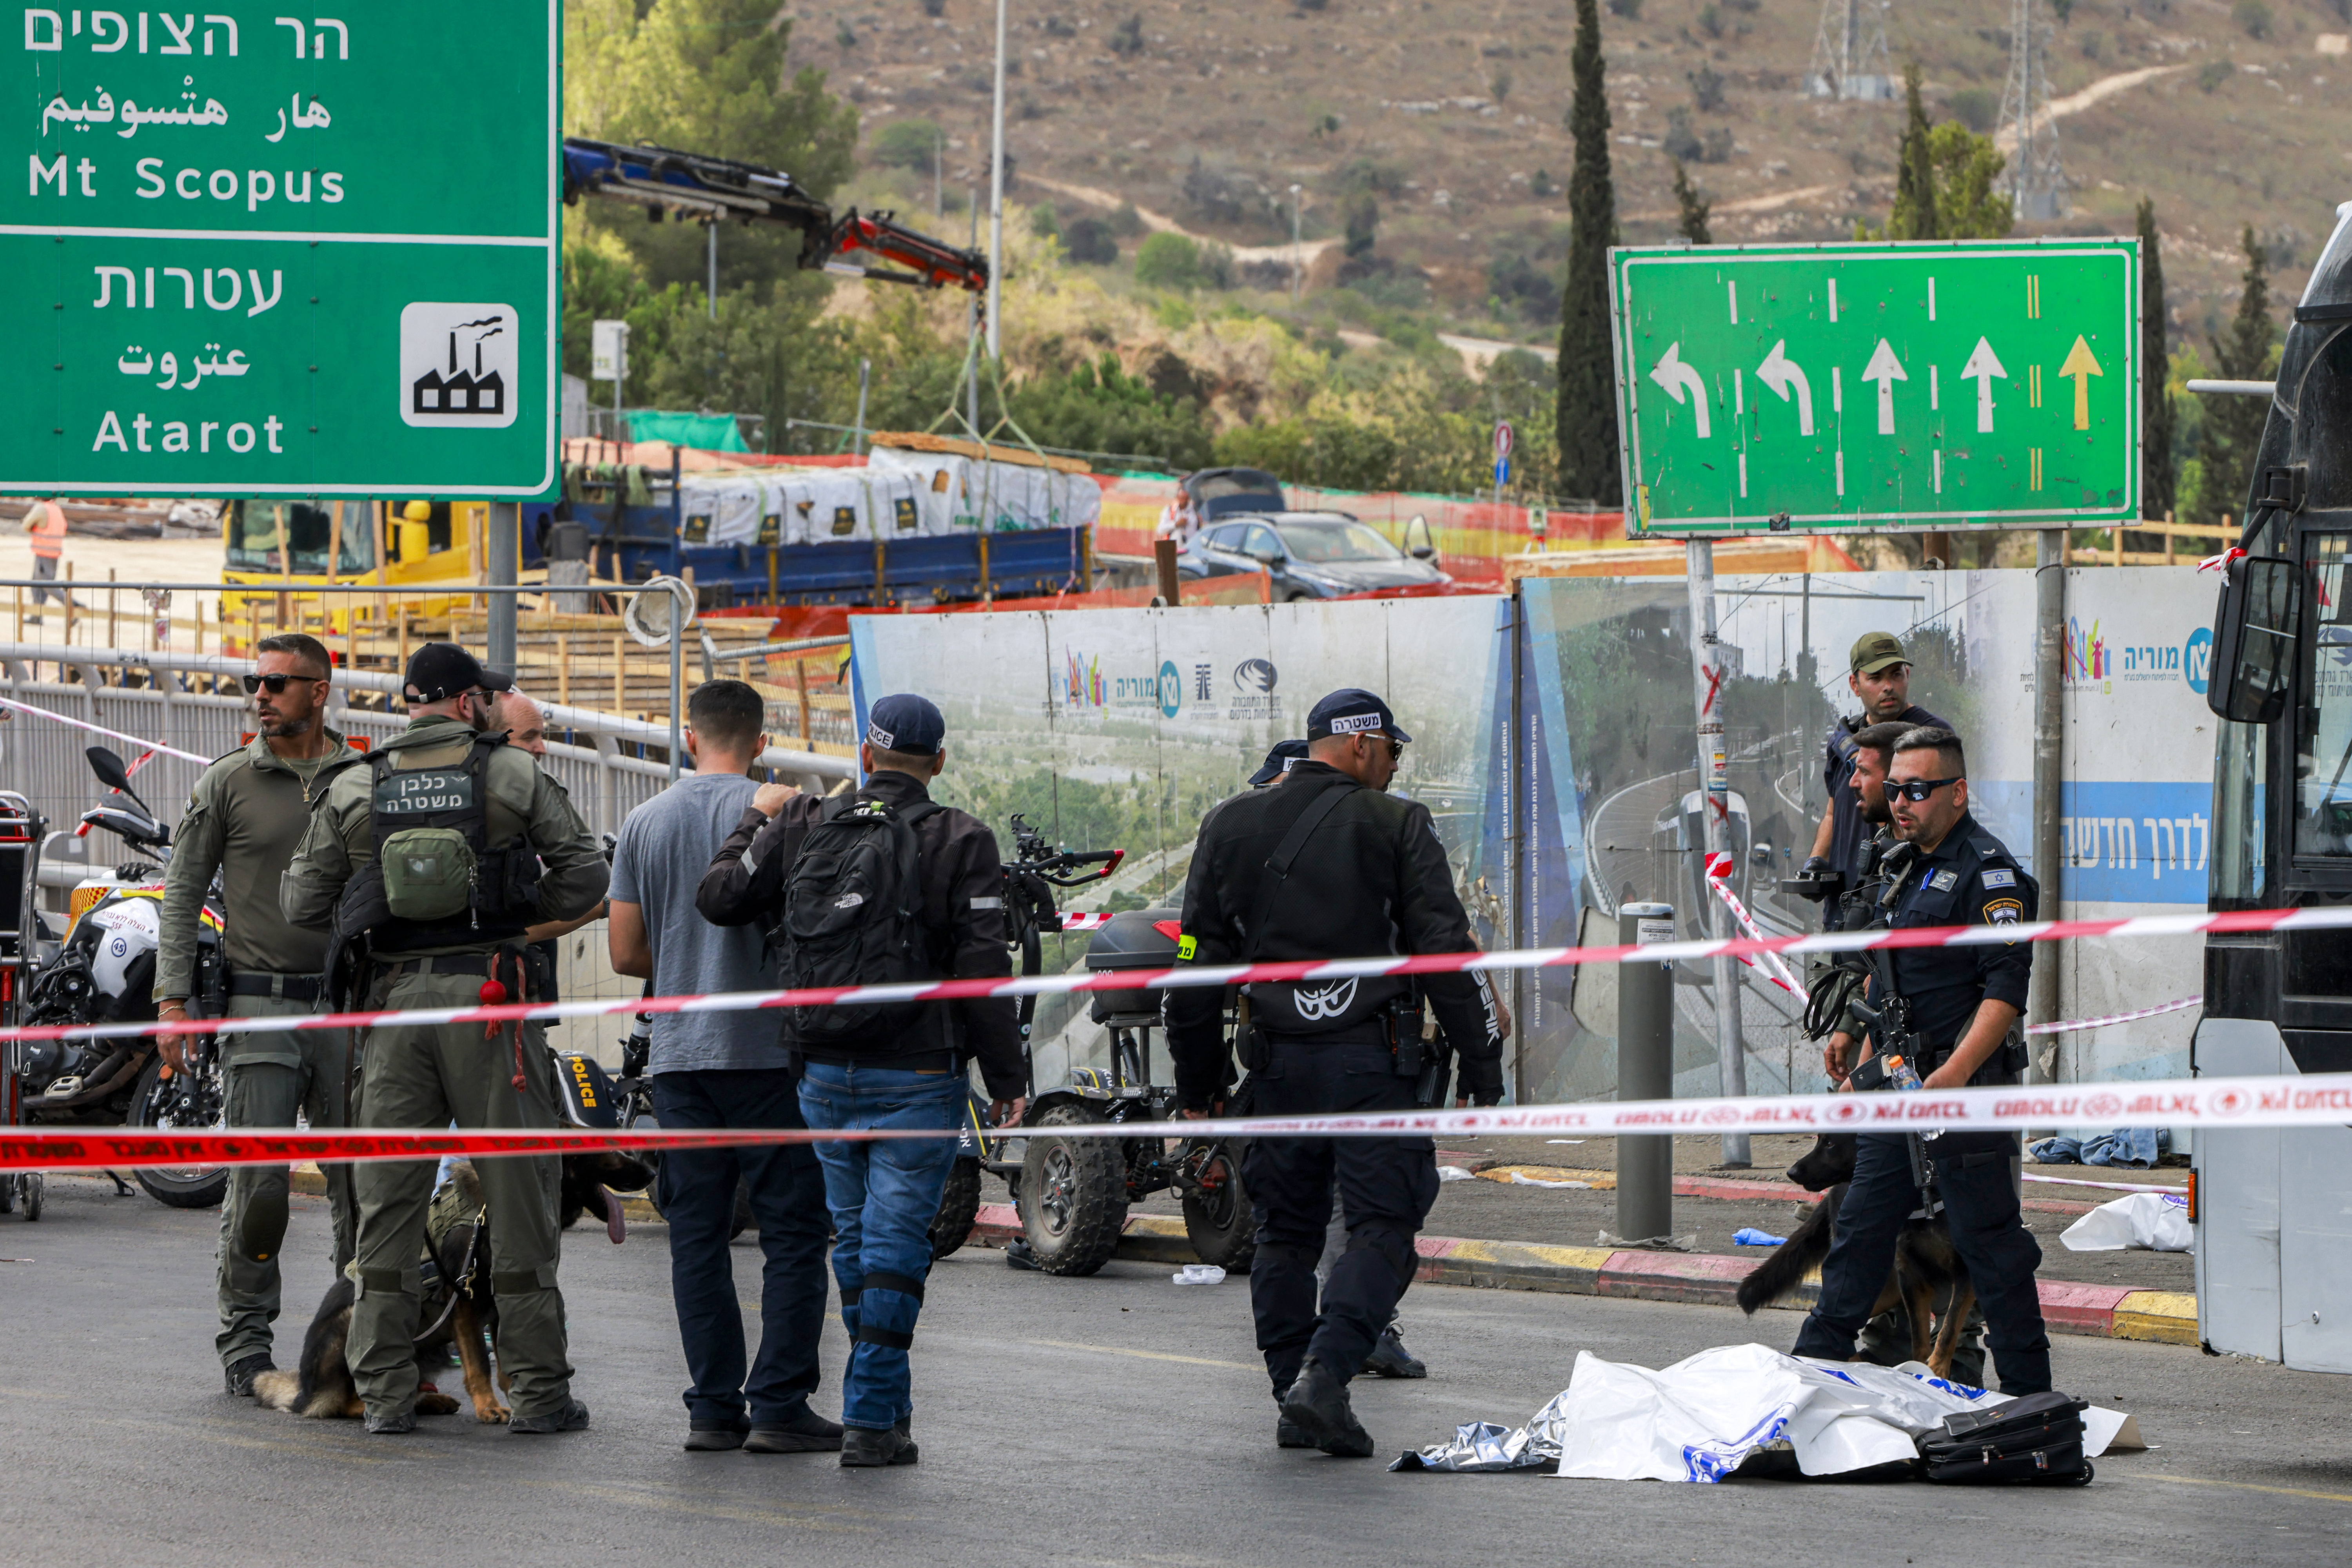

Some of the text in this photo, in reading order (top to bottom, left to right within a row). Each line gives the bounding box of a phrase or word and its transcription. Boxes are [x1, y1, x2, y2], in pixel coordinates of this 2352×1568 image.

[25, 9, 348, 60] הר הצופים
[265, 92, 331, 142] هار
[29, 152, 345, 211] Mt Scopus
[93, 266, 282, 318] עטרות
[118, 343, 250, 390] عتروت
[92, 411, 283, 453] Atarot
[2125, 647, 2179, 670] מוריה
[1117, 677, 1154, 697] מוריה
[1334, 715, 1380, 731] משטרה
[387, 793, 463, 812] משטרה
[401, 774, 446, 797] כלבן
[2144, 813, 2209, 880] לדרך
[1987, 902, 2003, 912] ישראל
[113, 942, 124, 953] 45
[567, 1056, 597, 1107] POLICE
